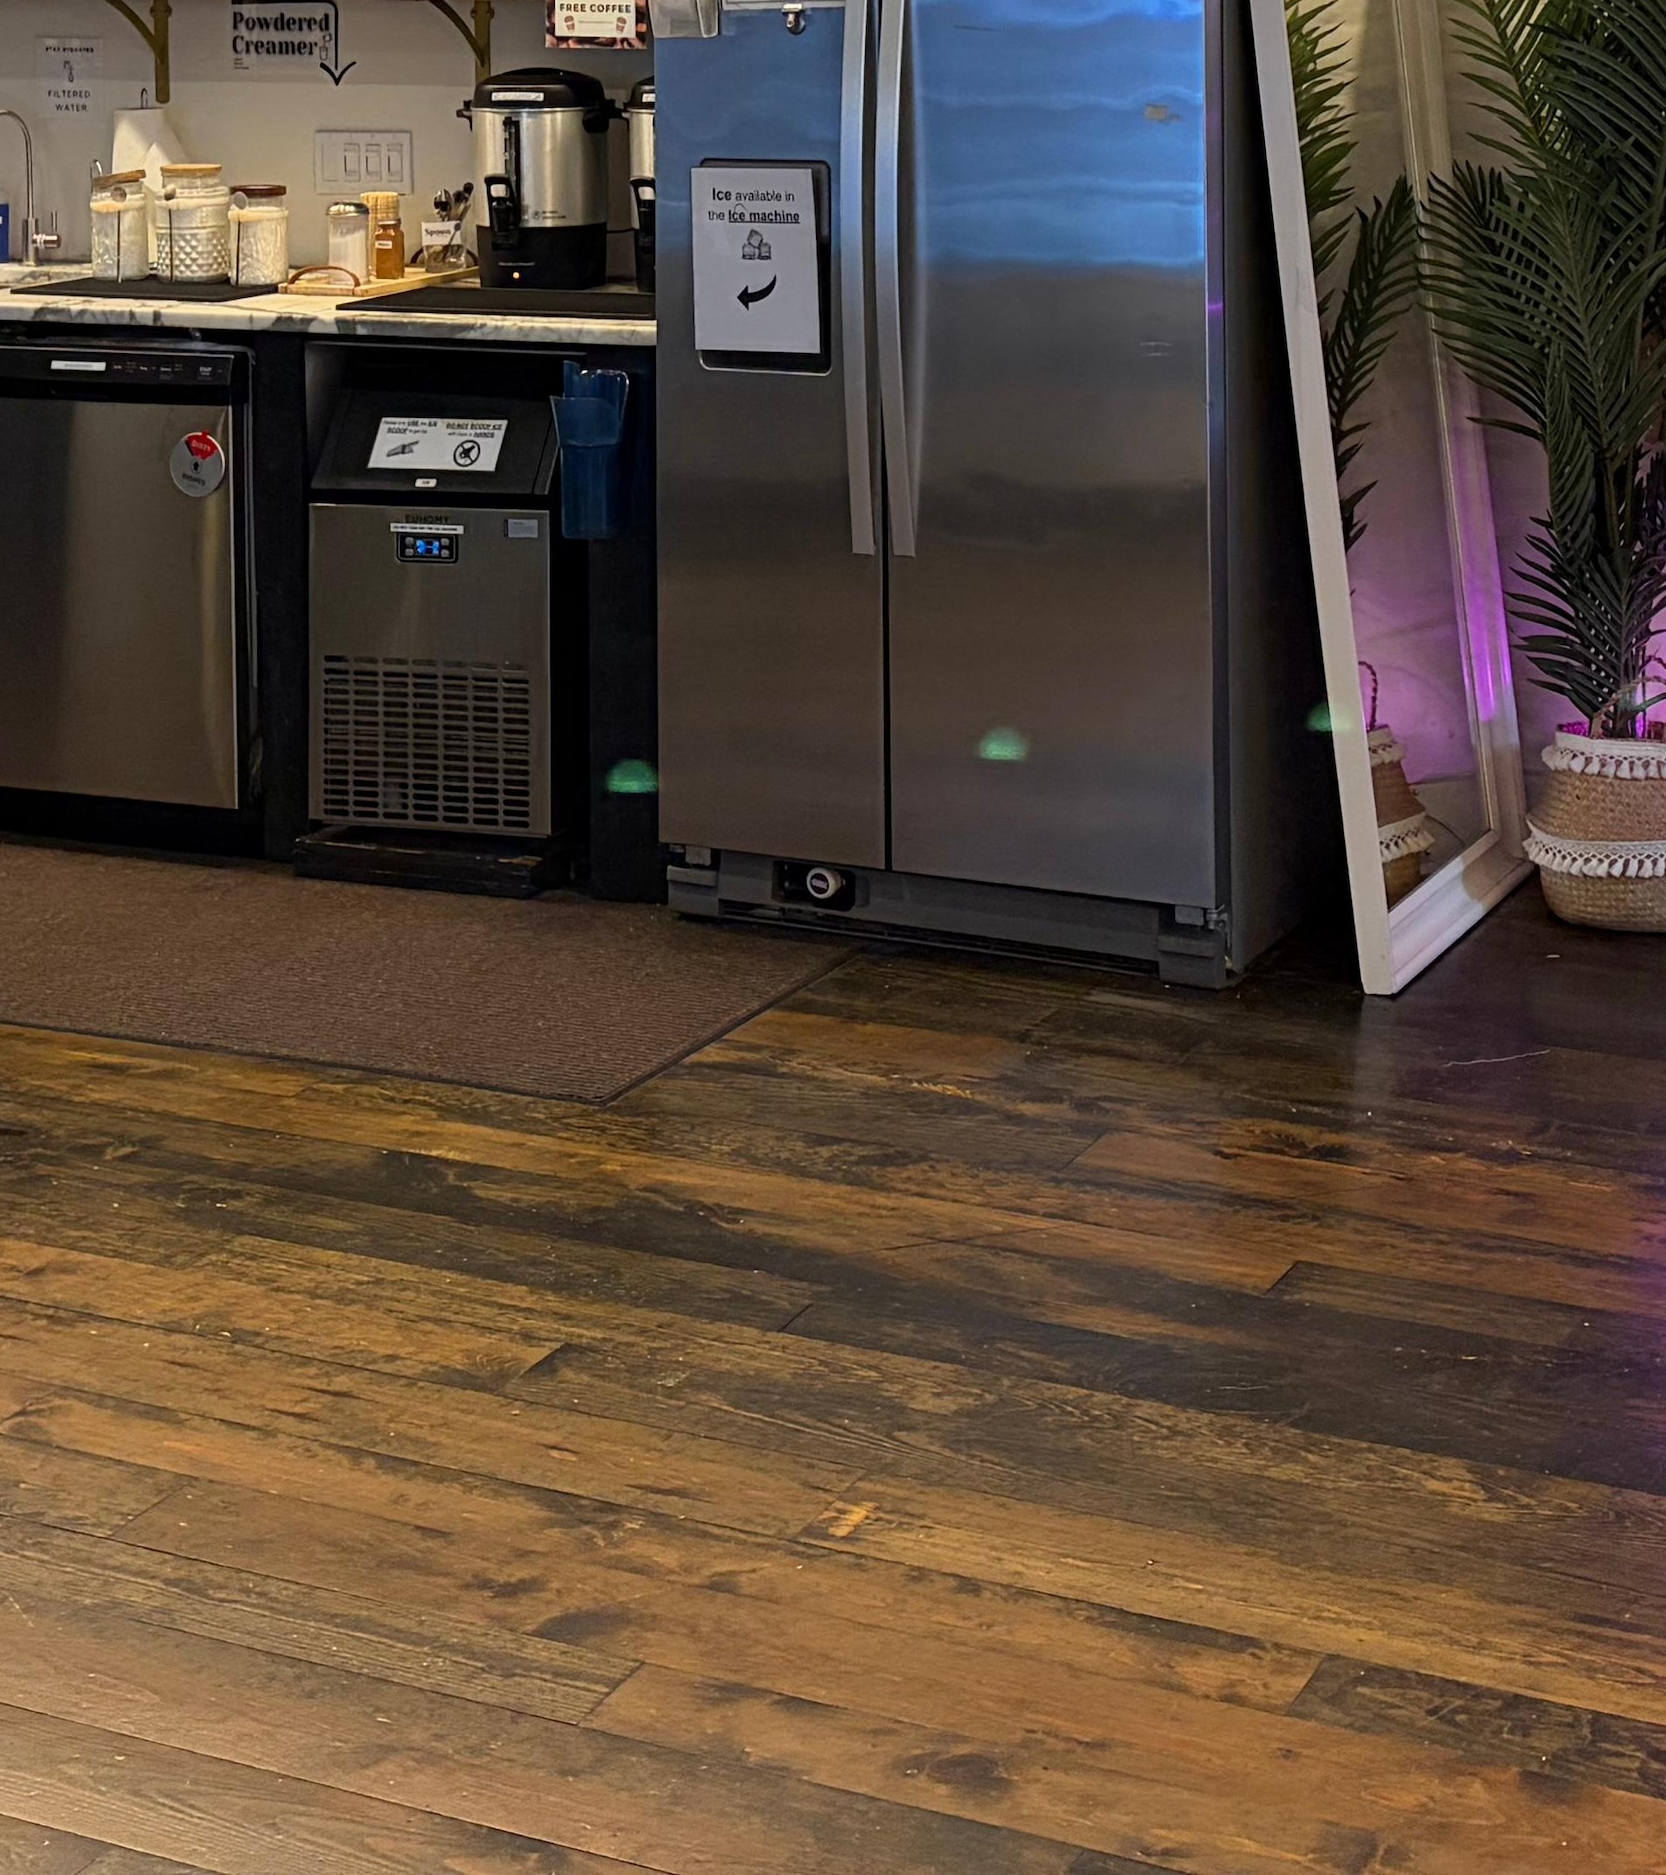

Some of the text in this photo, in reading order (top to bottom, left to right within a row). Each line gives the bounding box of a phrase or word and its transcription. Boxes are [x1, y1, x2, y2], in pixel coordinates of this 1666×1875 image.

[559, 3, 632, 14] FREE COFFEE
[233, 11, 330, 32] Powdered
[233, 35, 317, 55] Creamer
[48, 90, 91, 98] FILTERED
[56, 104, 88, 112] WATER
[712, 187, 795, 201] Ice available in
[708, 210, 800, 223] the Ice machine
